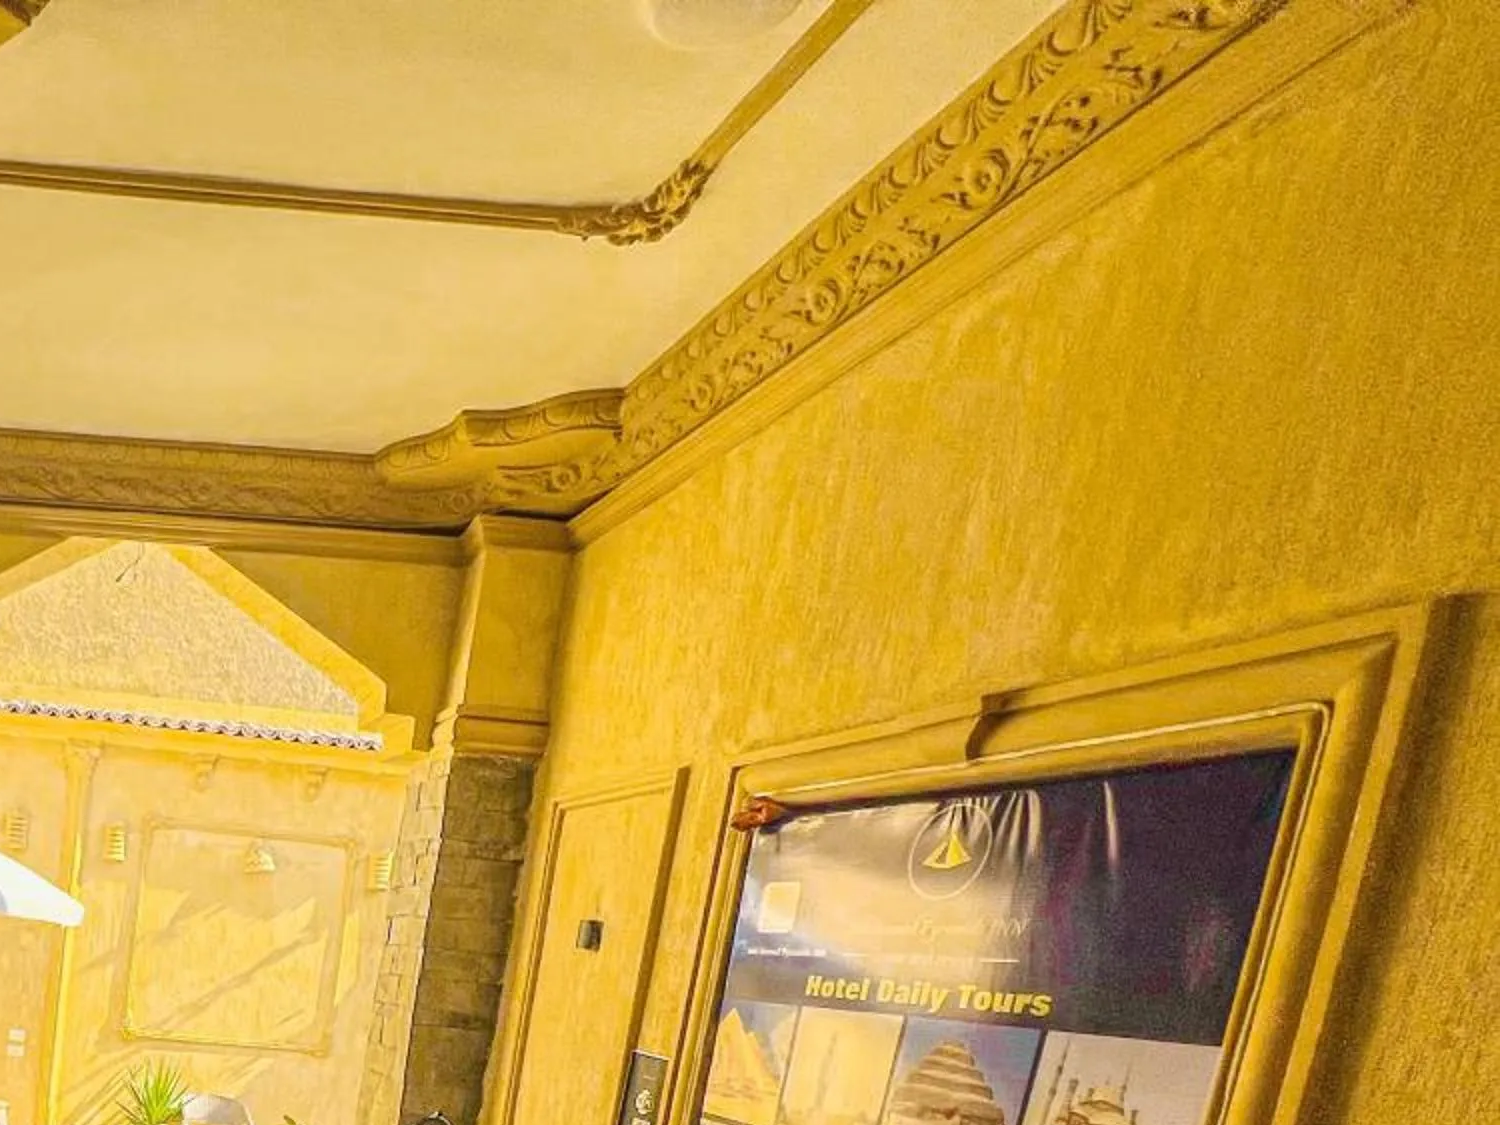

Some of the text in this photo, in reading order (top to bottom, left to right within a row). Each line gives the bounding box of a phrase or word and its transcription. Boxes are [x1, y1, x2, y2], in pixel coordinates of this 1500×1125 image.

[805, 974, 1053, 1017] Hotel Daily Tours
